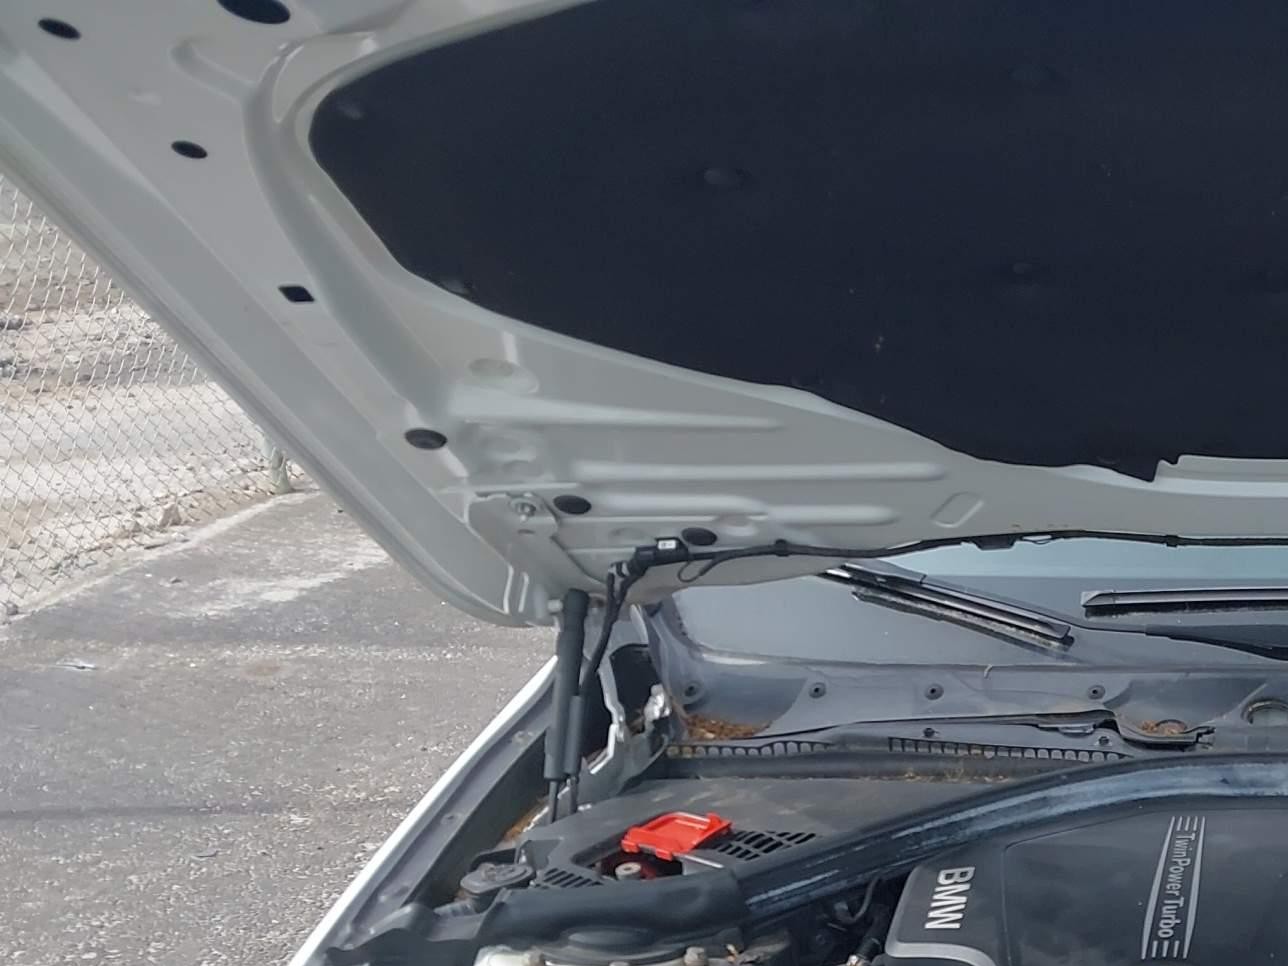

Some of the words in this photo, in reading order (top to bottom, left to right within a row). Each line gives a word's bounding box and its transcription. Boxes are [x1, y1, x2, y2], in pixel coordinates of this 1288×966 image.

[1165, 833, 1196, 896] TwinPower
[924, 866, 976, 929] BMW
[1157, 896, 1185, 938] Turbo
